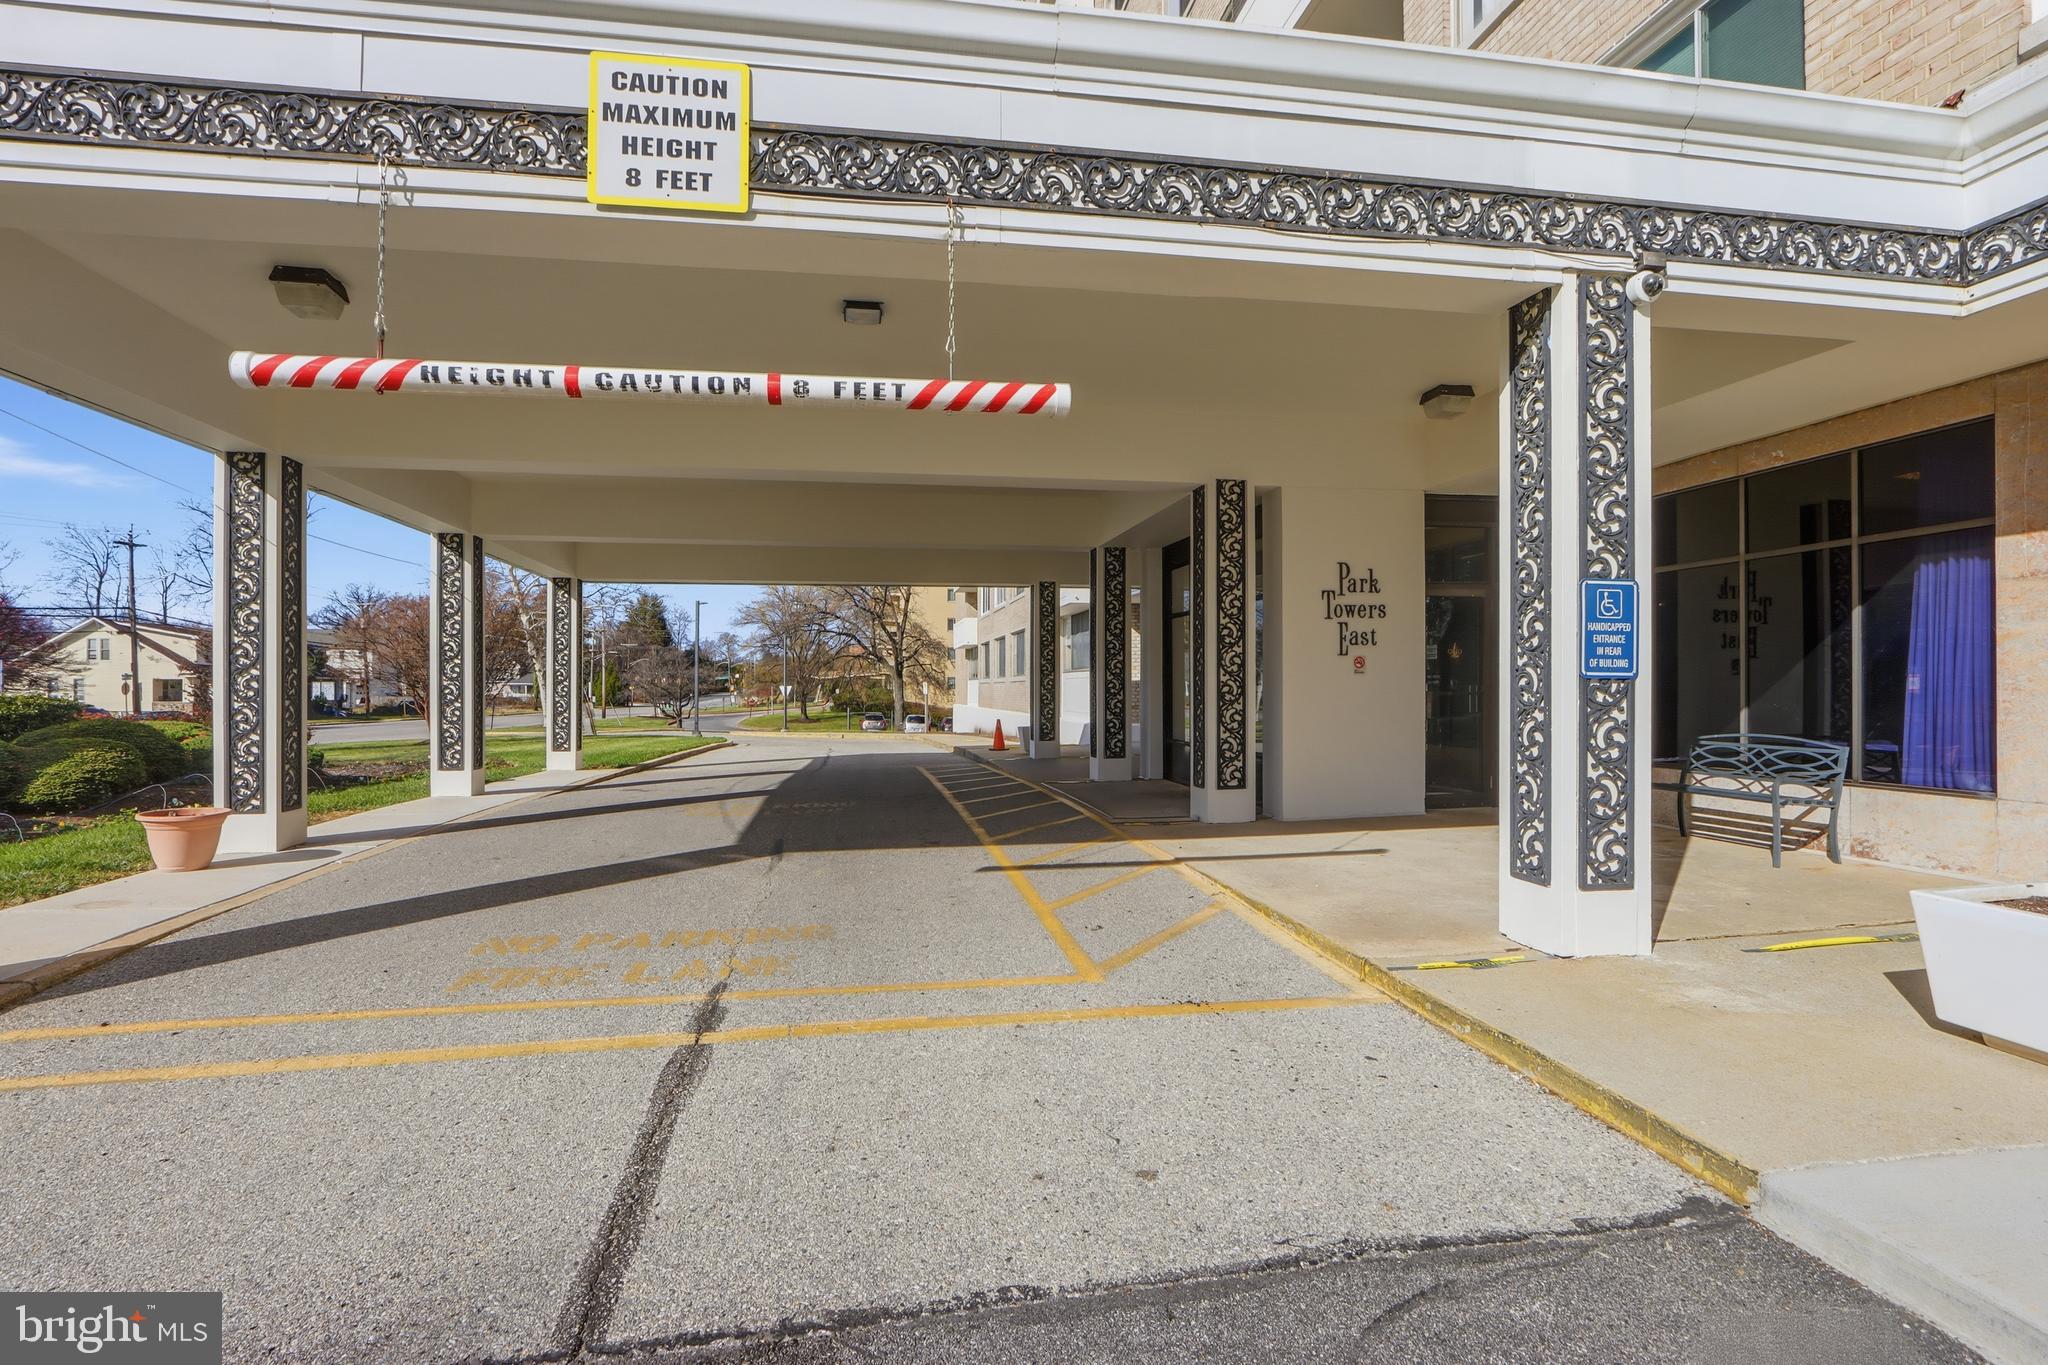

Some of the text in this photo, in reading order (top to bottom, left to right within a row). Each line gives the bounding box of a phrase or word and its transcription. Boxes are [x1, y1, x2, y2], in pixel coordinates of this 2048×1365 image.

[611, 71, 728, 99] CAUTION
[602, 102, 736, 131] MAXIMUM
[621, 135, 718, 161] HEIGHT
[625, 167, 713, 192] 8 FEET
[420, 364, 906, 402] HEIGHT CAUTION 8 FEET
[1337, 562, 1381, 596] Park
[1321, 590, 1387, 620] Towers
[1337, 622, 1378, 656] East
[1587, 622, 1631, 632] HANDICAPPED
[1593, 635, 1626, 643] ENTRANCE
[1589, 659, 1629, 668] OF BUILDING
[1597, 647, 1622, 656] IN REAR
